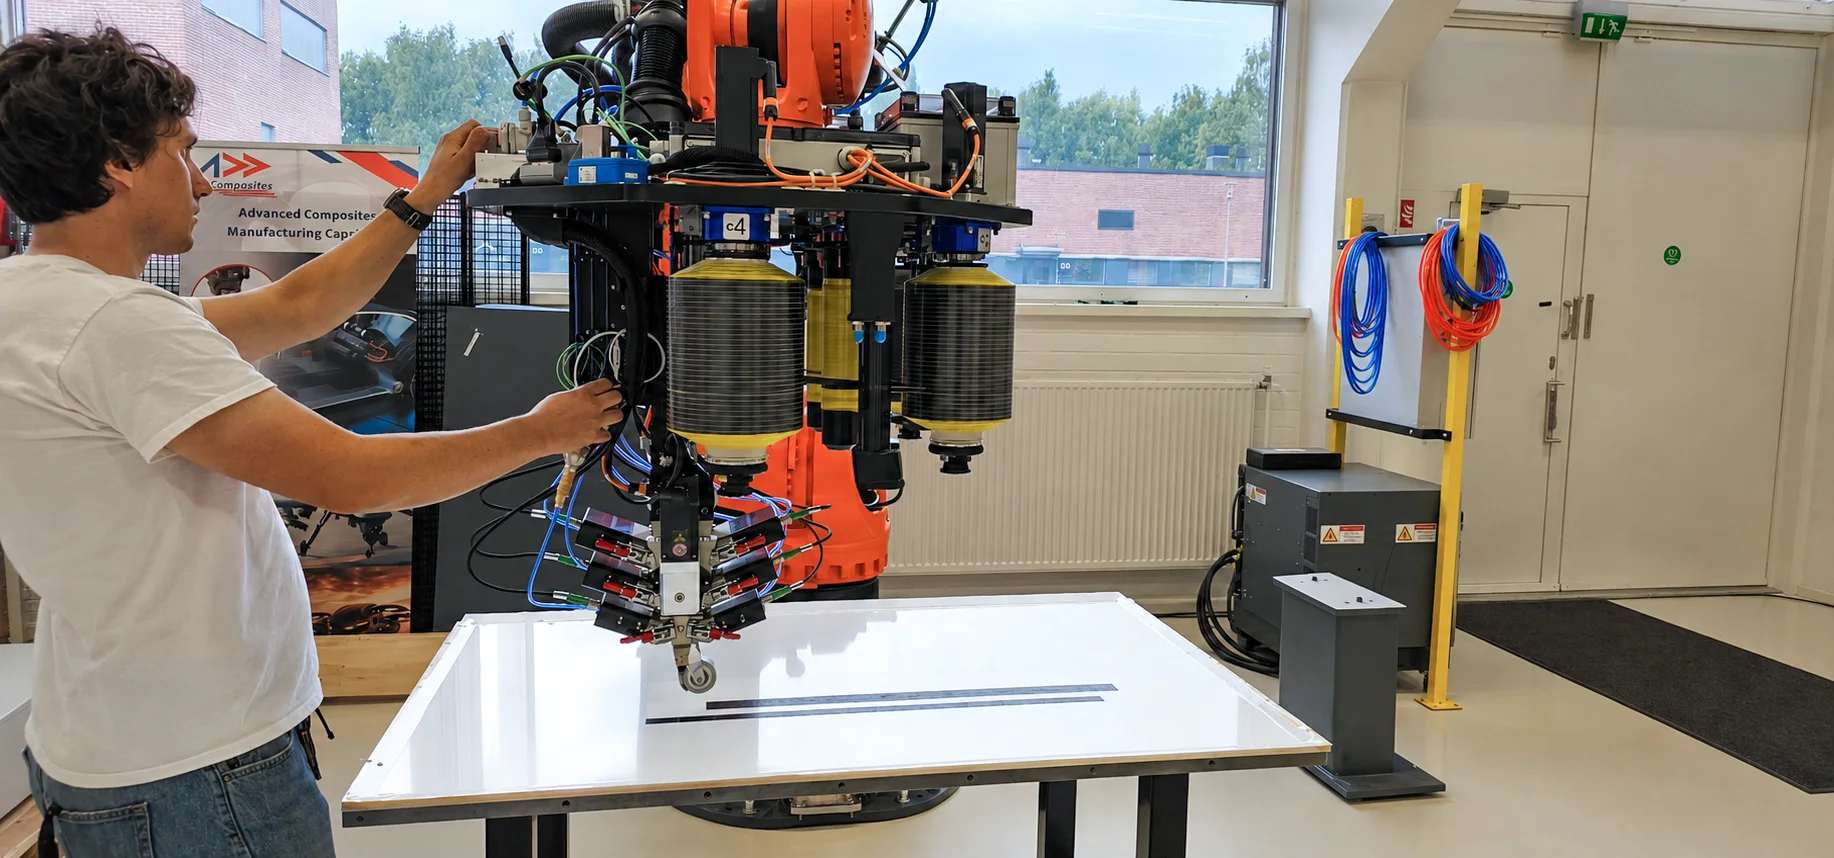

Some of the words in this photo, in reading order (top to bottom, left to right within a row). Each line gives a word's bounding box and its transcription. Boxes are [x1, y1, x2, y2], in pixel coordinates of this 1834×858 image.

[238, 207, 300, 219] Advanced
[304, 209, 376, 222] Composites
[227, 226, 322, 240] Manufacturing
[726, 217, 746, 235] c4
